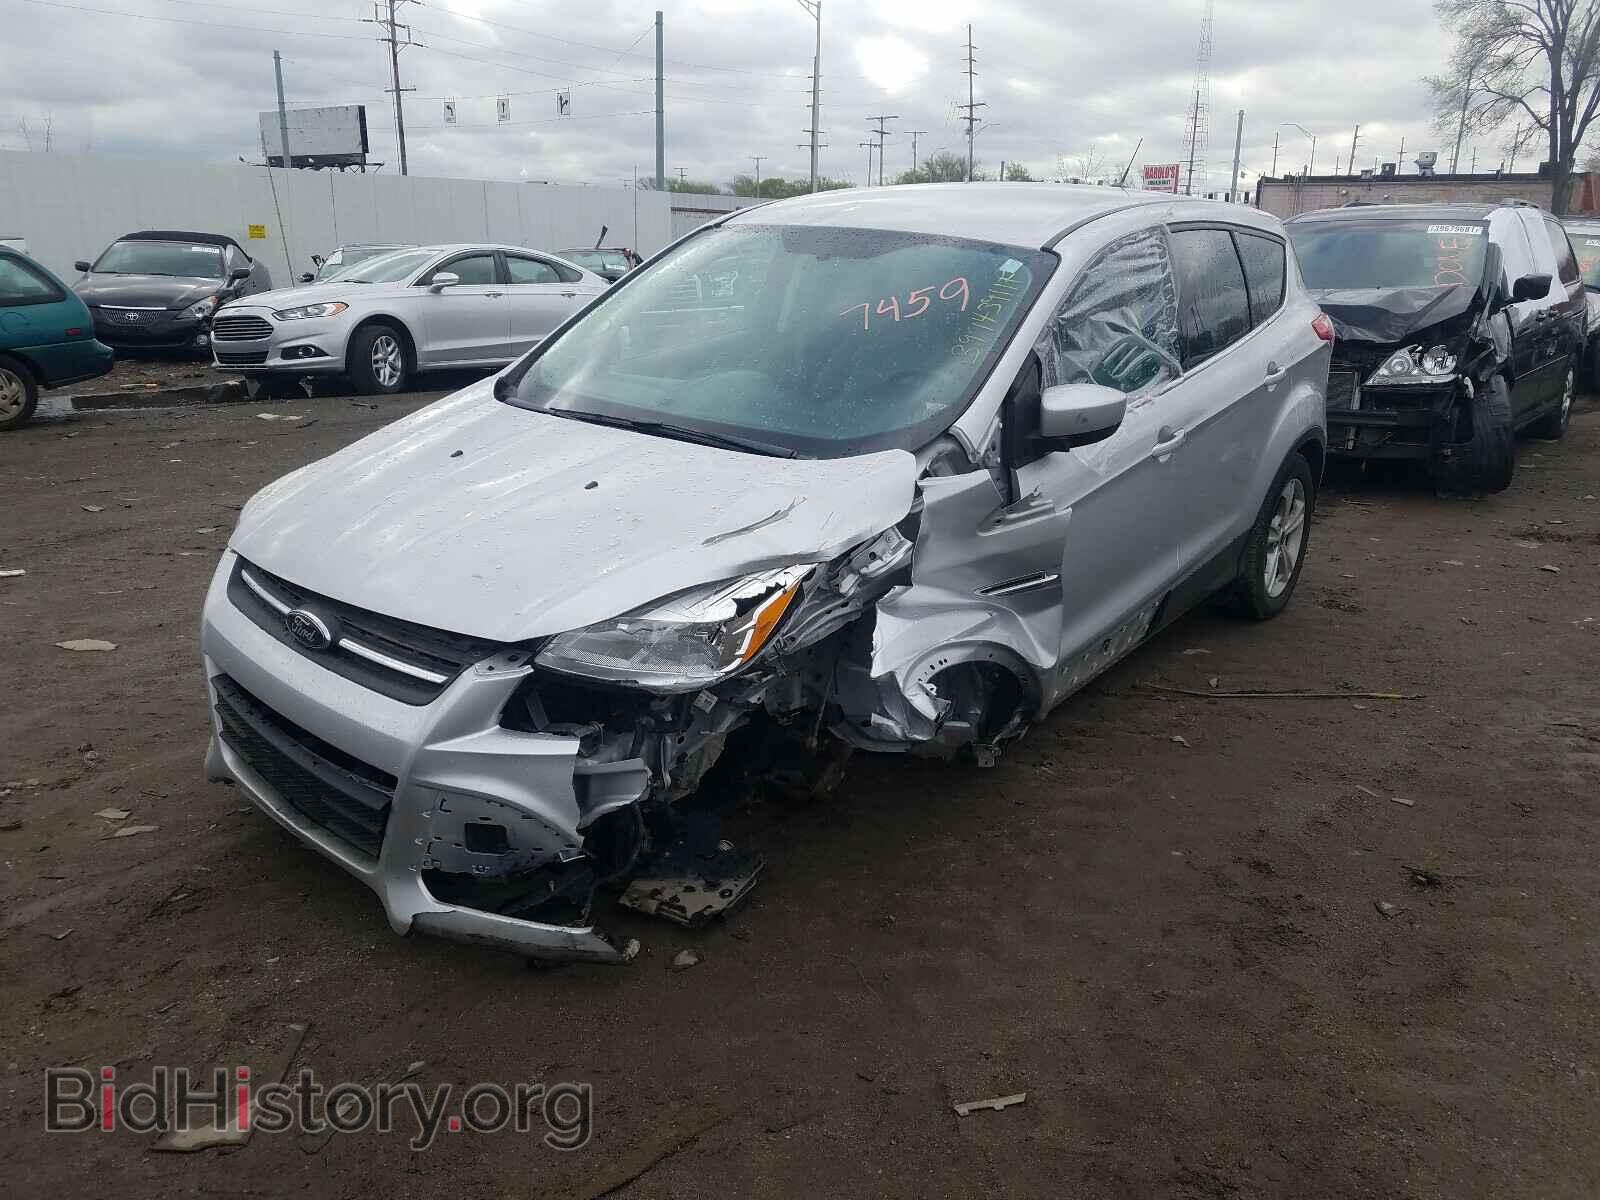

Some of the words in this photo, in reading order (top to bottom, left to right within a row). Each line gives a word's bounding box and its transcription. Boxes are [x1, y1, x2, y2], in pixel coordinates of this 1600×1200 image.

[1144, 166, 1176, 179] HAROLD'S
[840, 277, 970, 330] 7459
[291, 615, 317, 641] Ford
